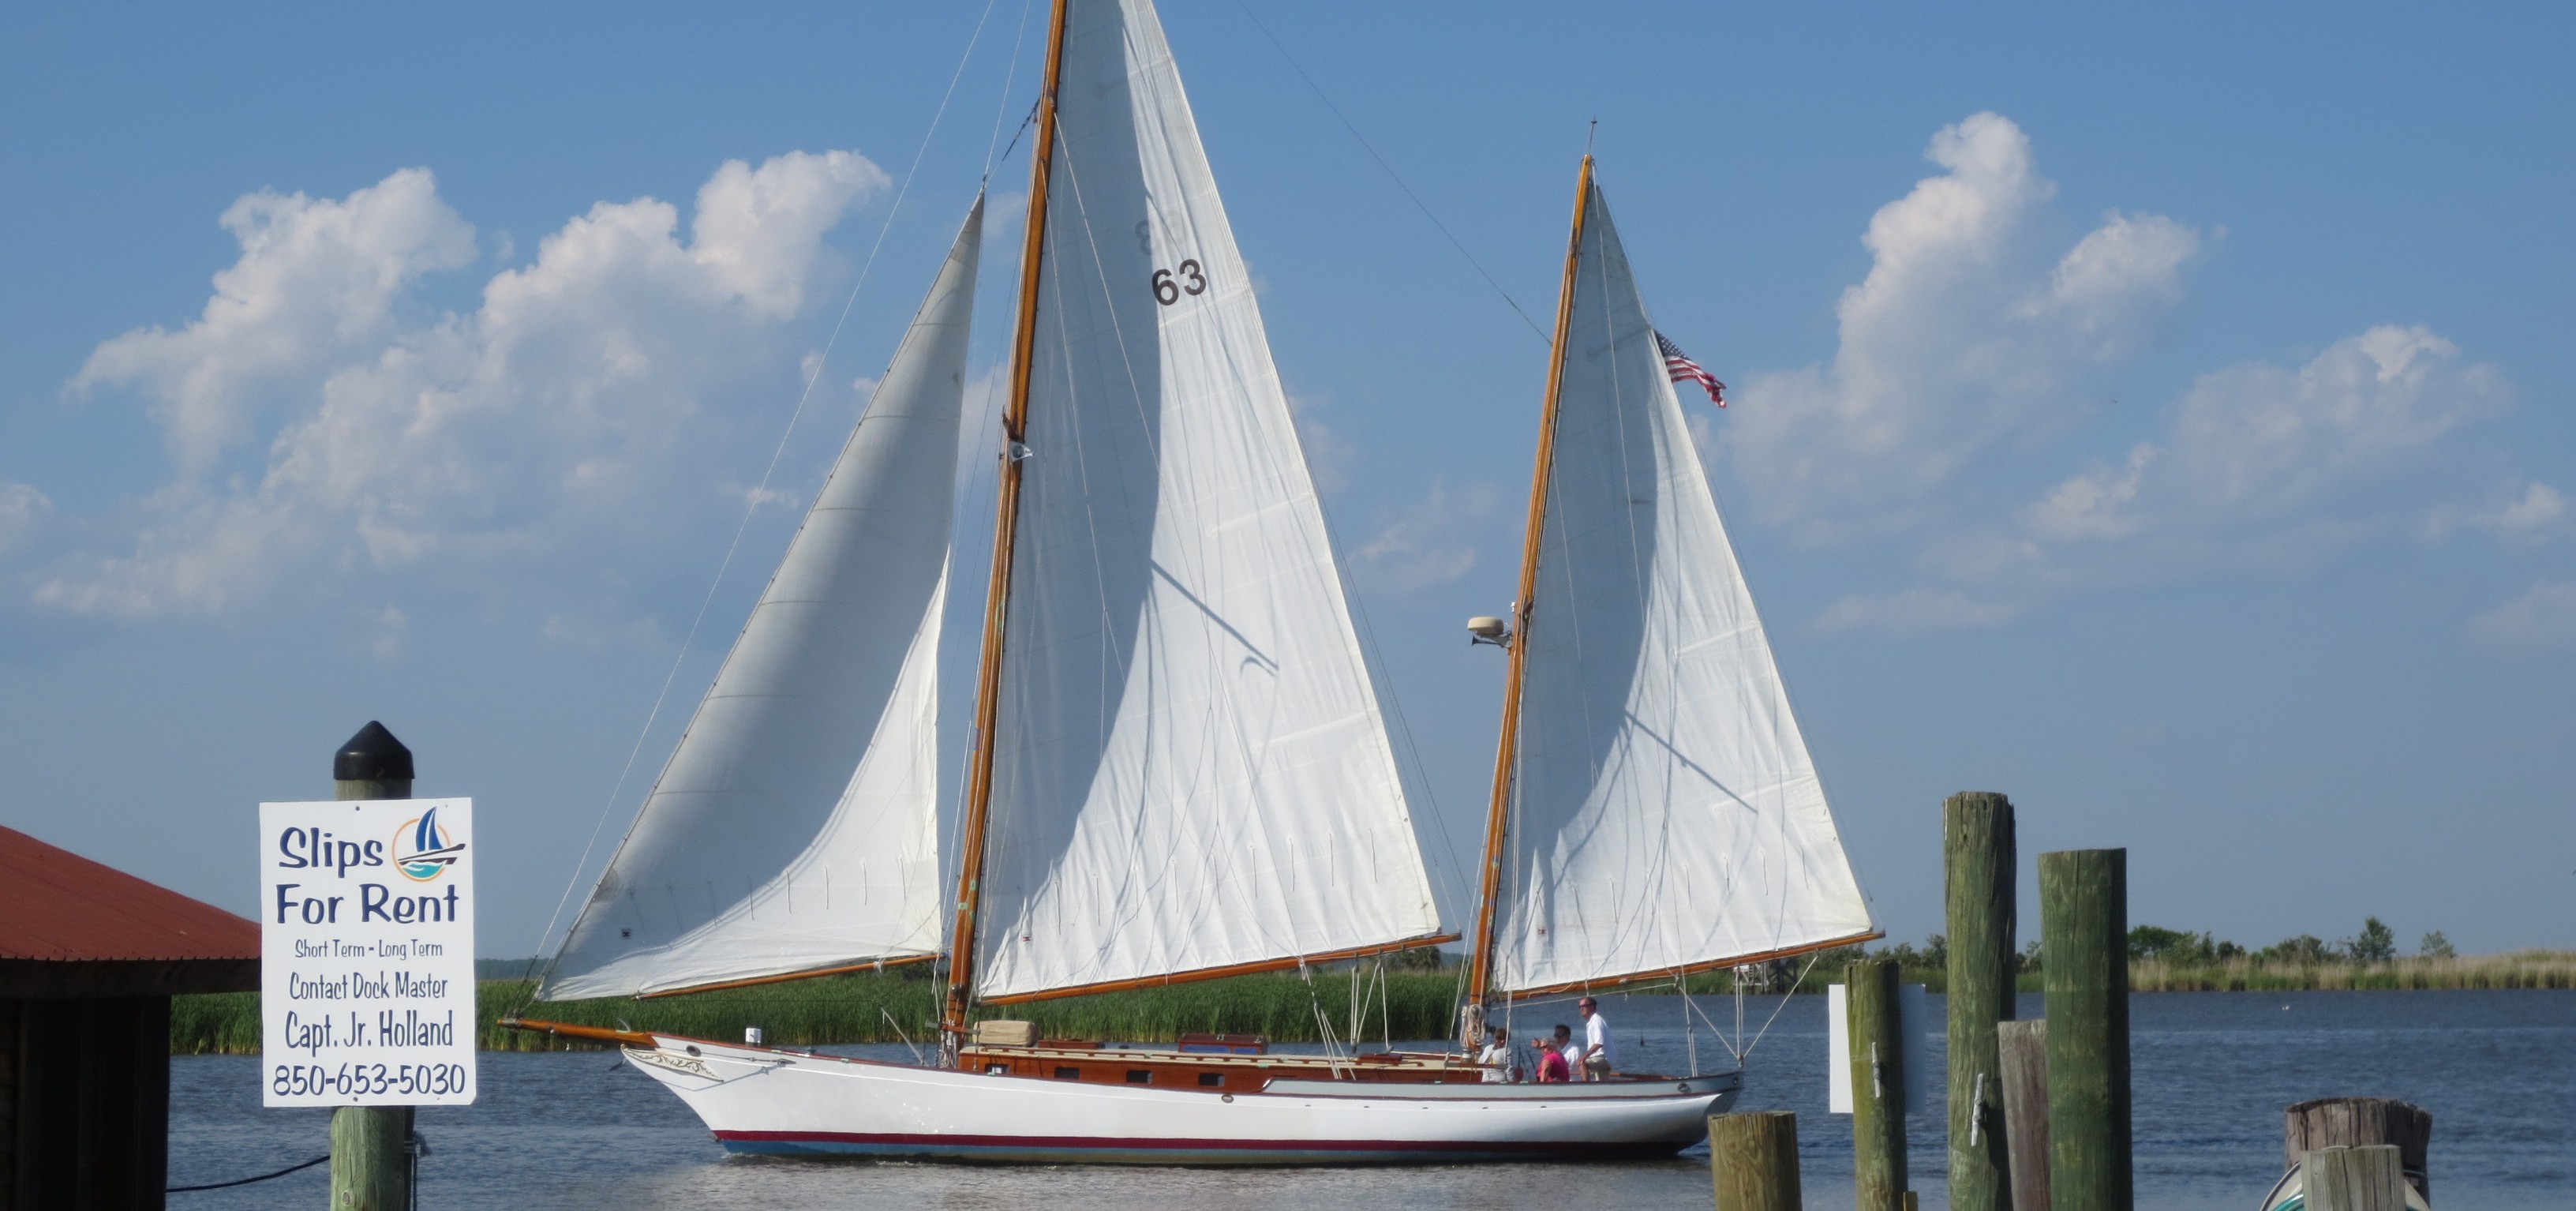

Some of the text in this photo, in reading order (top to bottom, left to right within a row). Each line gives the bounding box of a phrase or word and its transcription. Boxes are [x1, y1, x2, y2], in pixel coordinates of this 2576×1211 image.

[1151, 258, 1207, 306] 63
[279, 827, 383, 878] Slips
[276, 883, 459, 924] For Rent
[295, 939, 328, 958] Short
[333, 939, 364, 957] Term
[379, 939, 406, 960] Long
[411, 939, 442, 955] Term
[290, 971, 447, 999] Contact Dock Master
[286, 1010, 452, 1057] Capt. Jr. Holland
[274, 1063, 465, 1097] 850-653-5030
